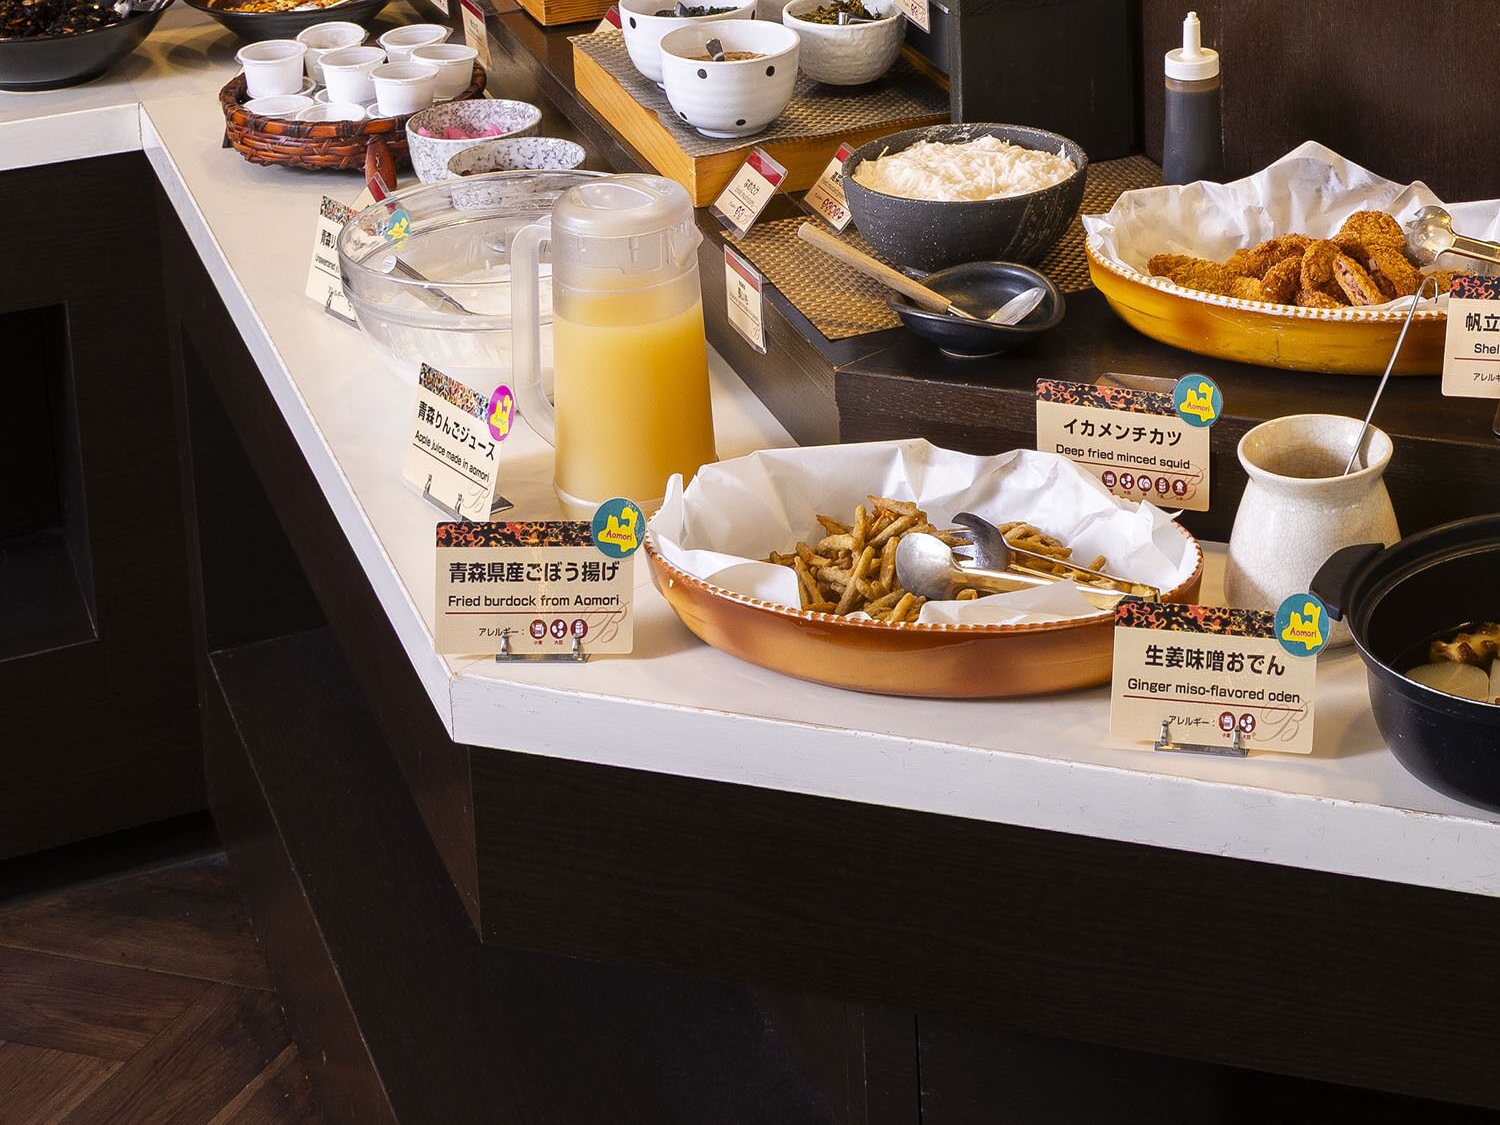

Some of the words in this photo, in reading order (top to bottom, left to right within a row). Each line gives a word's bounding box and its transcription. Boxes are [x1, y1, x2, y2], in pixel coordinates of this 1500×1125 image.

[1186, 402, 1211, 413] Aomori
[418, 400, 495, 461] 青森りんごジュース
[1063, 418, 1183, 447] イカメンチカツ
[415, 430, 431, 446] Apple
[431, 439, 446, 455] juice
[446, 450, 462, 466] made
[462, 458, 468, 470] in
[469, 464, 489, 483] aomori
[1056, 444, 1085, 458] Deep
[1087, 448, 1114, 461] fried
[1117, 453, 1157, 466] minced
[1159, 458, 1190, 470] squid
[606, 530, 633, 541] Aomori
[449, 560, 620, 583] 青森県産ごぼう揚げ
[448, 596, 481, 607] Fried
[484, 595, 536, 607] burdock
[540, 595, 570, 606] from
[574, 594, 620, 606] Aomori
[1290, 626, 1317, 638] Aomori
[1144, 645, 1286, 676] 生姜味噌おでん
[1127, 678, 1172, 693] Ginger
[1175, 683, 1265, 701] miso-flavored
[1268, 690, 1300, 704] oden
